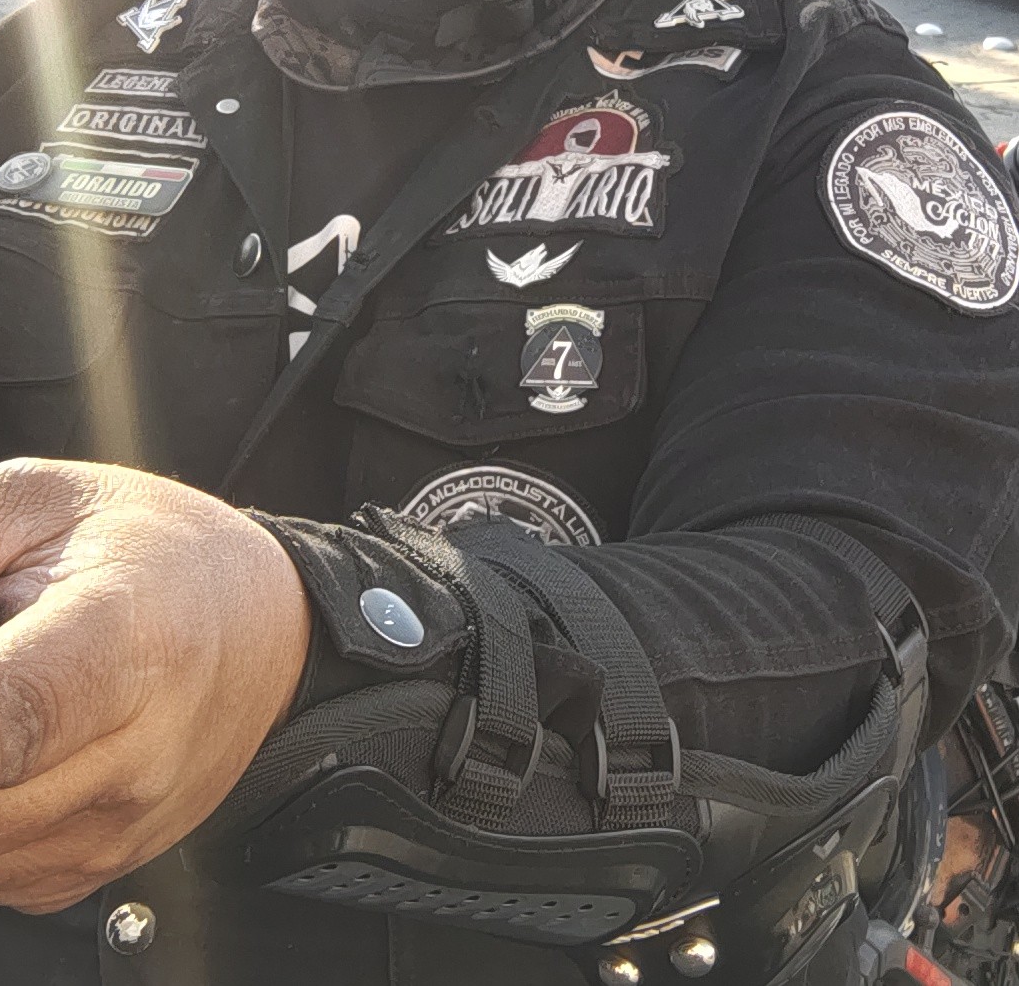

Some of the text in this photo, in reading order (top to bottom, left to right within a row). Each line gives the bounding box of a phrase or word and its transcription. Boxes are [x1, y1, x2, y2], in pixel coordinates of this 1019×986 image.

[71, 110, 205, 141] ORIGINAL
[855, 123, 884, 148] POR
[882, 117, 906, 132] MIS
[908, 117, 968, 163] EMBLEMAS
[60, 172, 163, 200] FORAJIDO
[834, 152, 855, 201] LEGADO
[838, 202, 858, 219] MI
[848, 217, 875, 246] POR
[880, 249, 1000, 302] SIEMPRE FUERTES
[552, 340, 573, 380] 7
